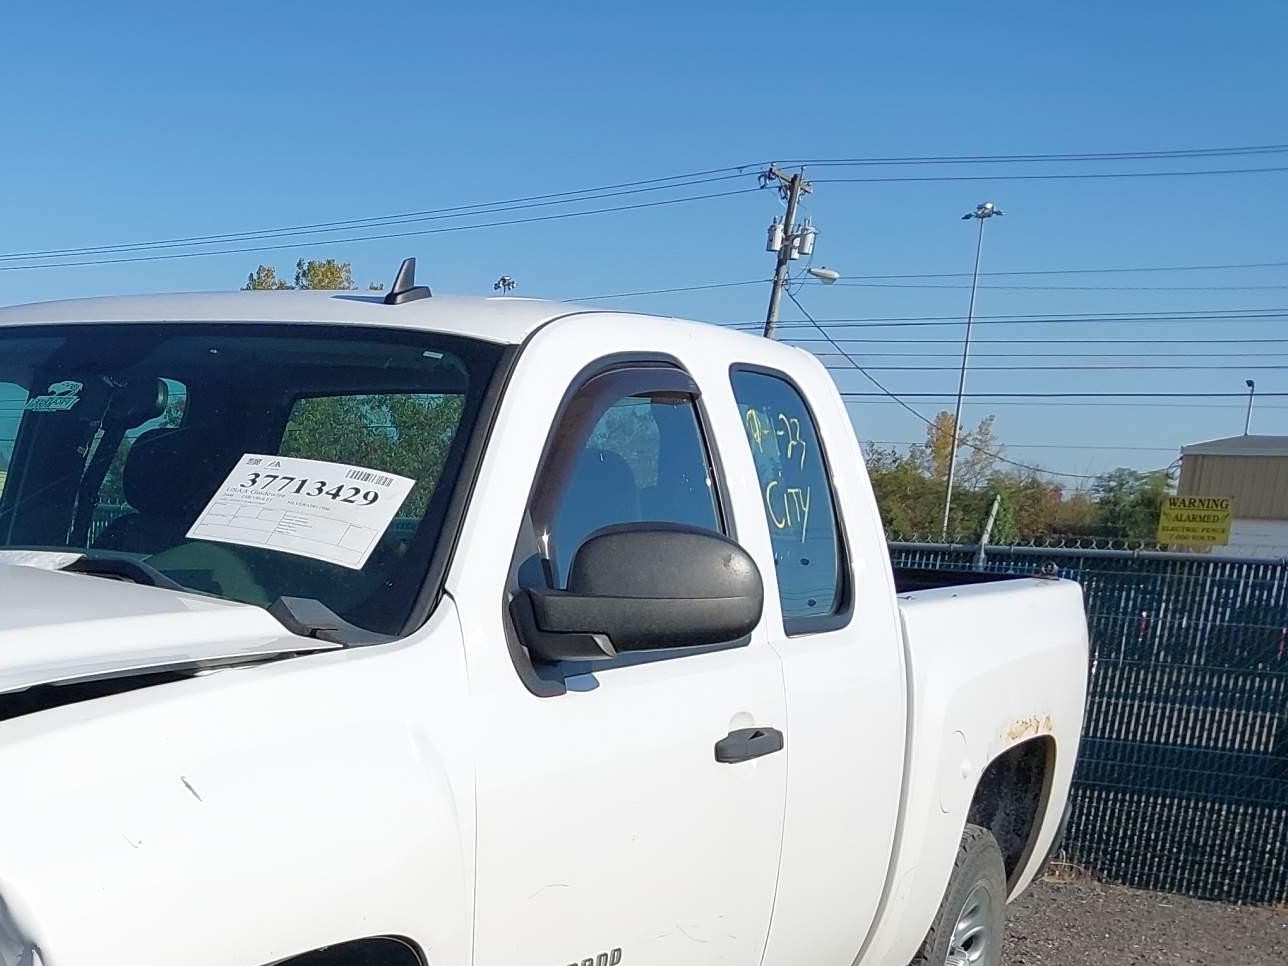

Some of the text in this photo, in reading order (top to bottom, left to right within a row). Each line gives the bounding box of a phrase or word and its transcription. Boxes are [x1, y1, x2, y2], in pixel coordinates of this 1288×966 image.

[239, 472, 379, 506] 37713429
[1169, 498, 1229, 509] WARNING
[1172, 513, 1219, 523] ALARMED
